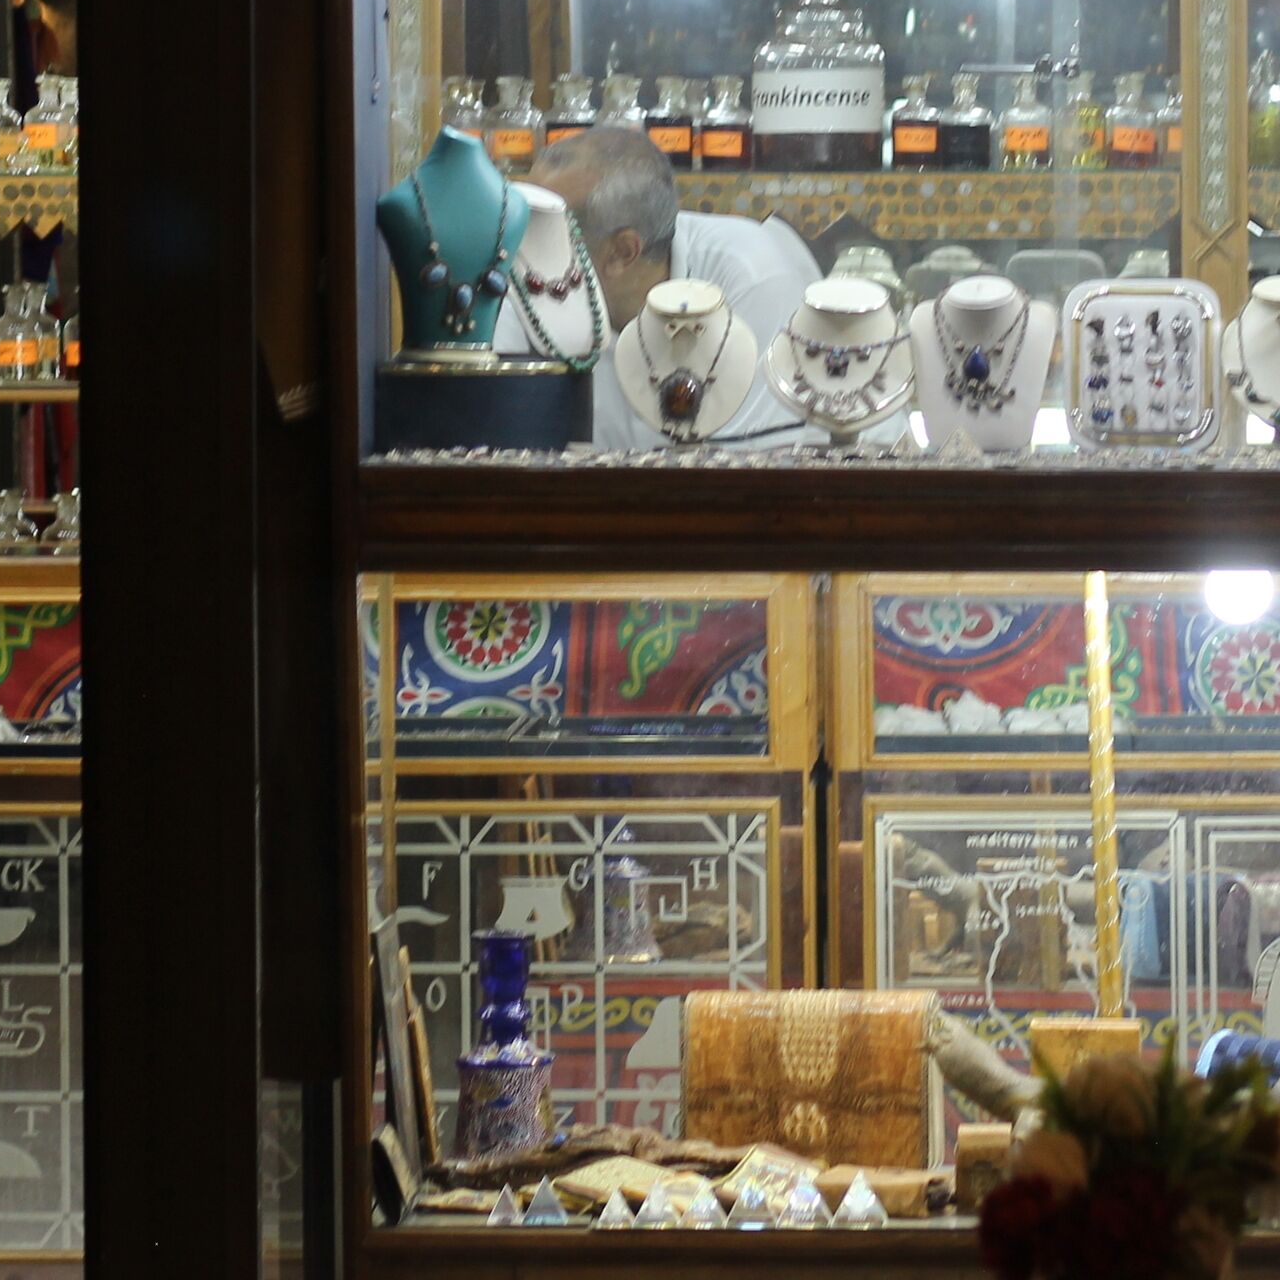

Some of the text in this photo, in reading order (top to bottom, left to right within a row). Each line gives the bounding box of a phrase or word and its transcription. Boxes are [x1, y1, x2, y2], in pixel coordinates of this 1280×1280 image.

[0, 857, 45, 893] CK
[421, 857, 721, 900] F G H
[0, 979, 26, 1014] L
[425, 976, 586, 1024] O P
[14, 1105, 52, 1137] T
